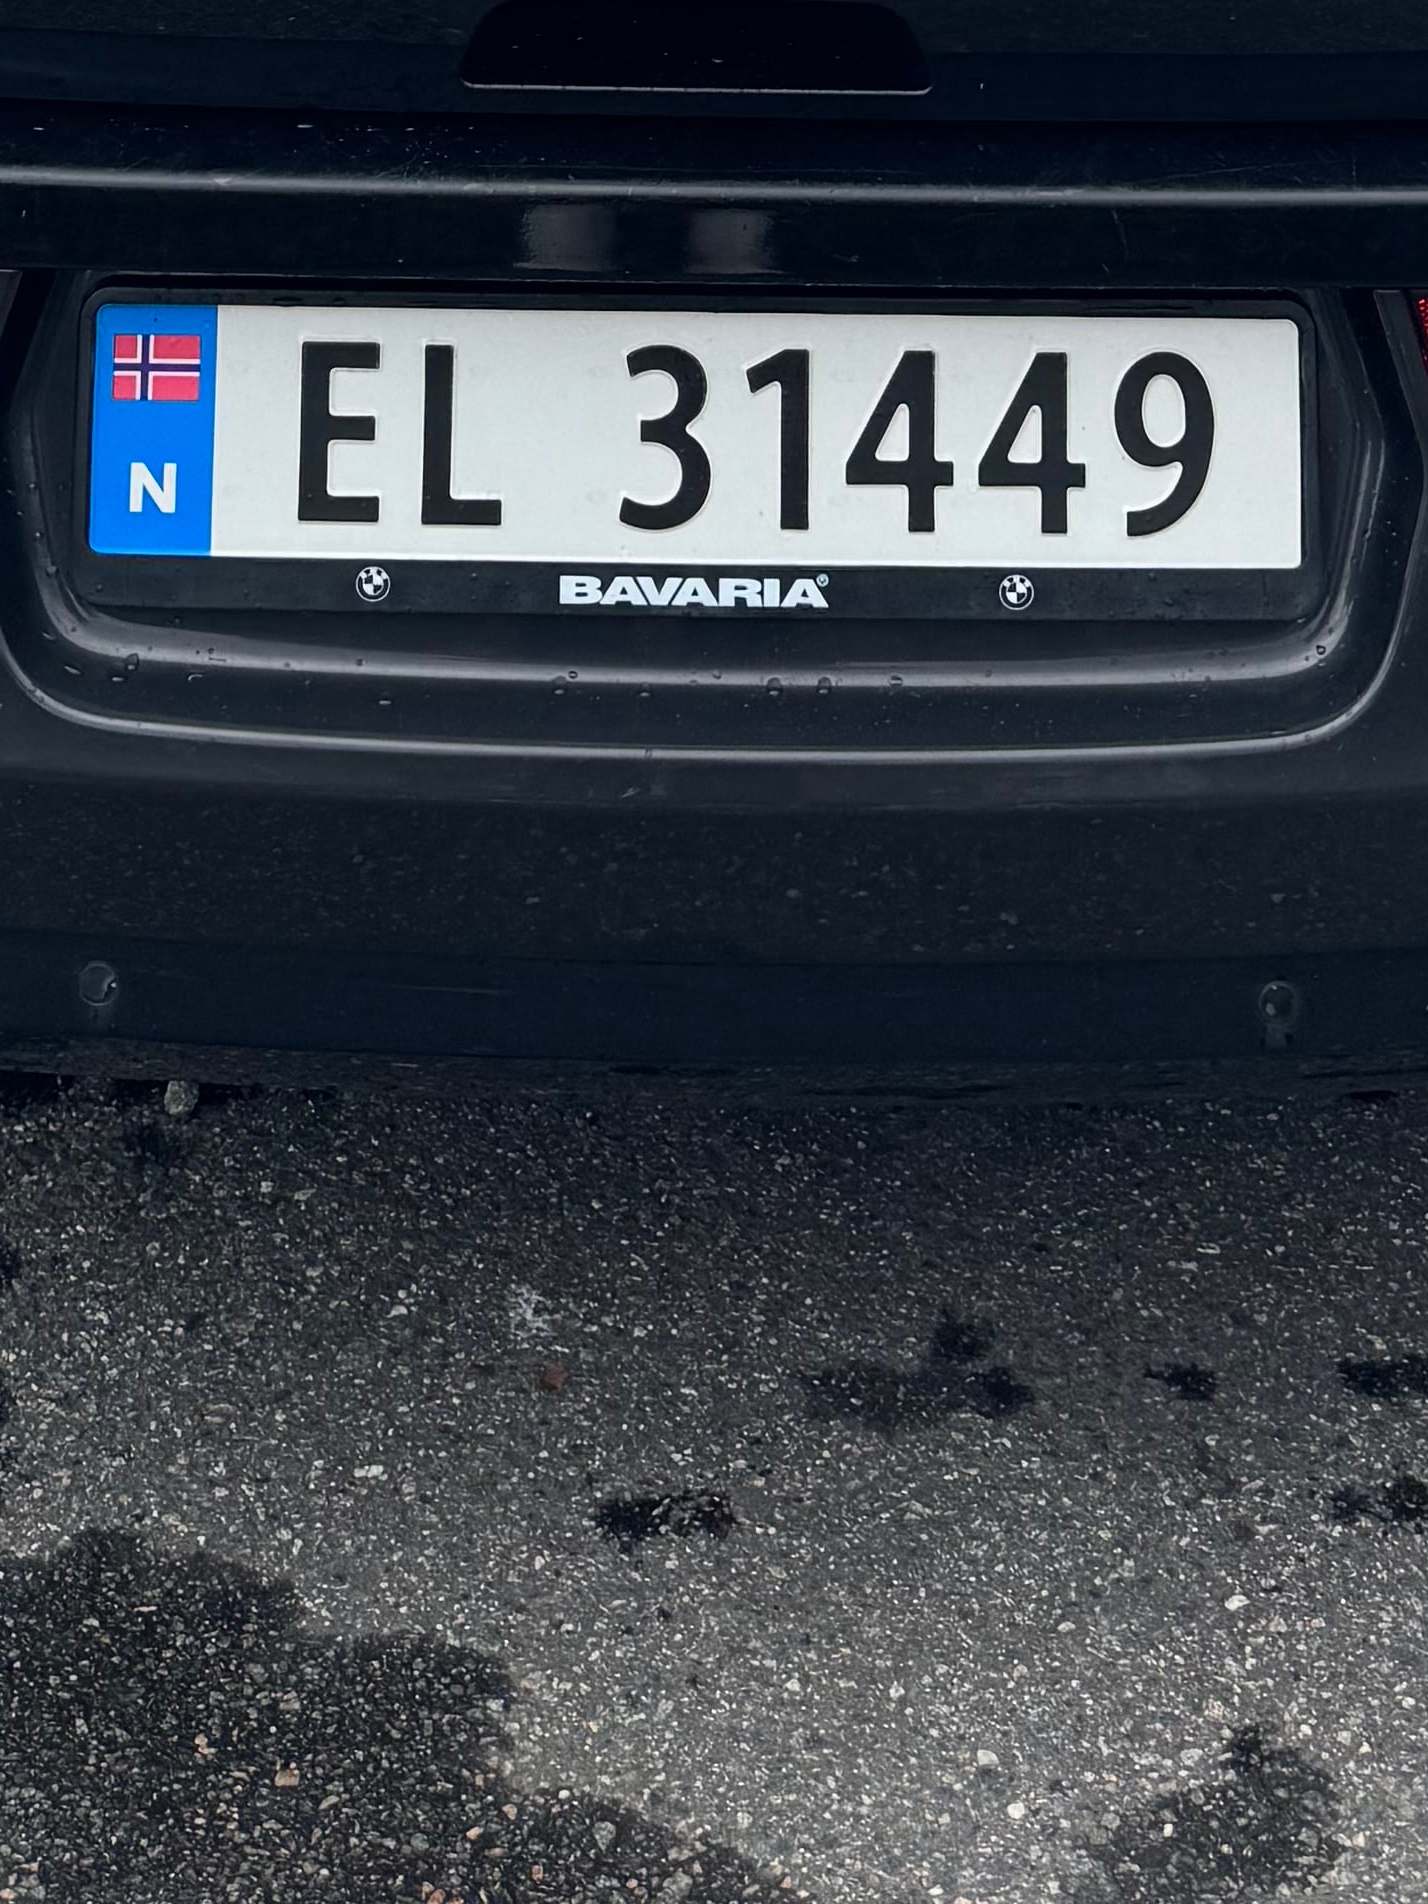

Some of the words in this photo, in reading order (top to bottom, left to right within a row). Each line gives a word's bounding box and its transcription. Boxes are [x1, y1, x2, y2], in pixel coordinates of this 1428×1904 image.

[129, 461, 178, 514] N
[298, 340, 503, 526] EL
[619, 344, 1215, 537] 31449
